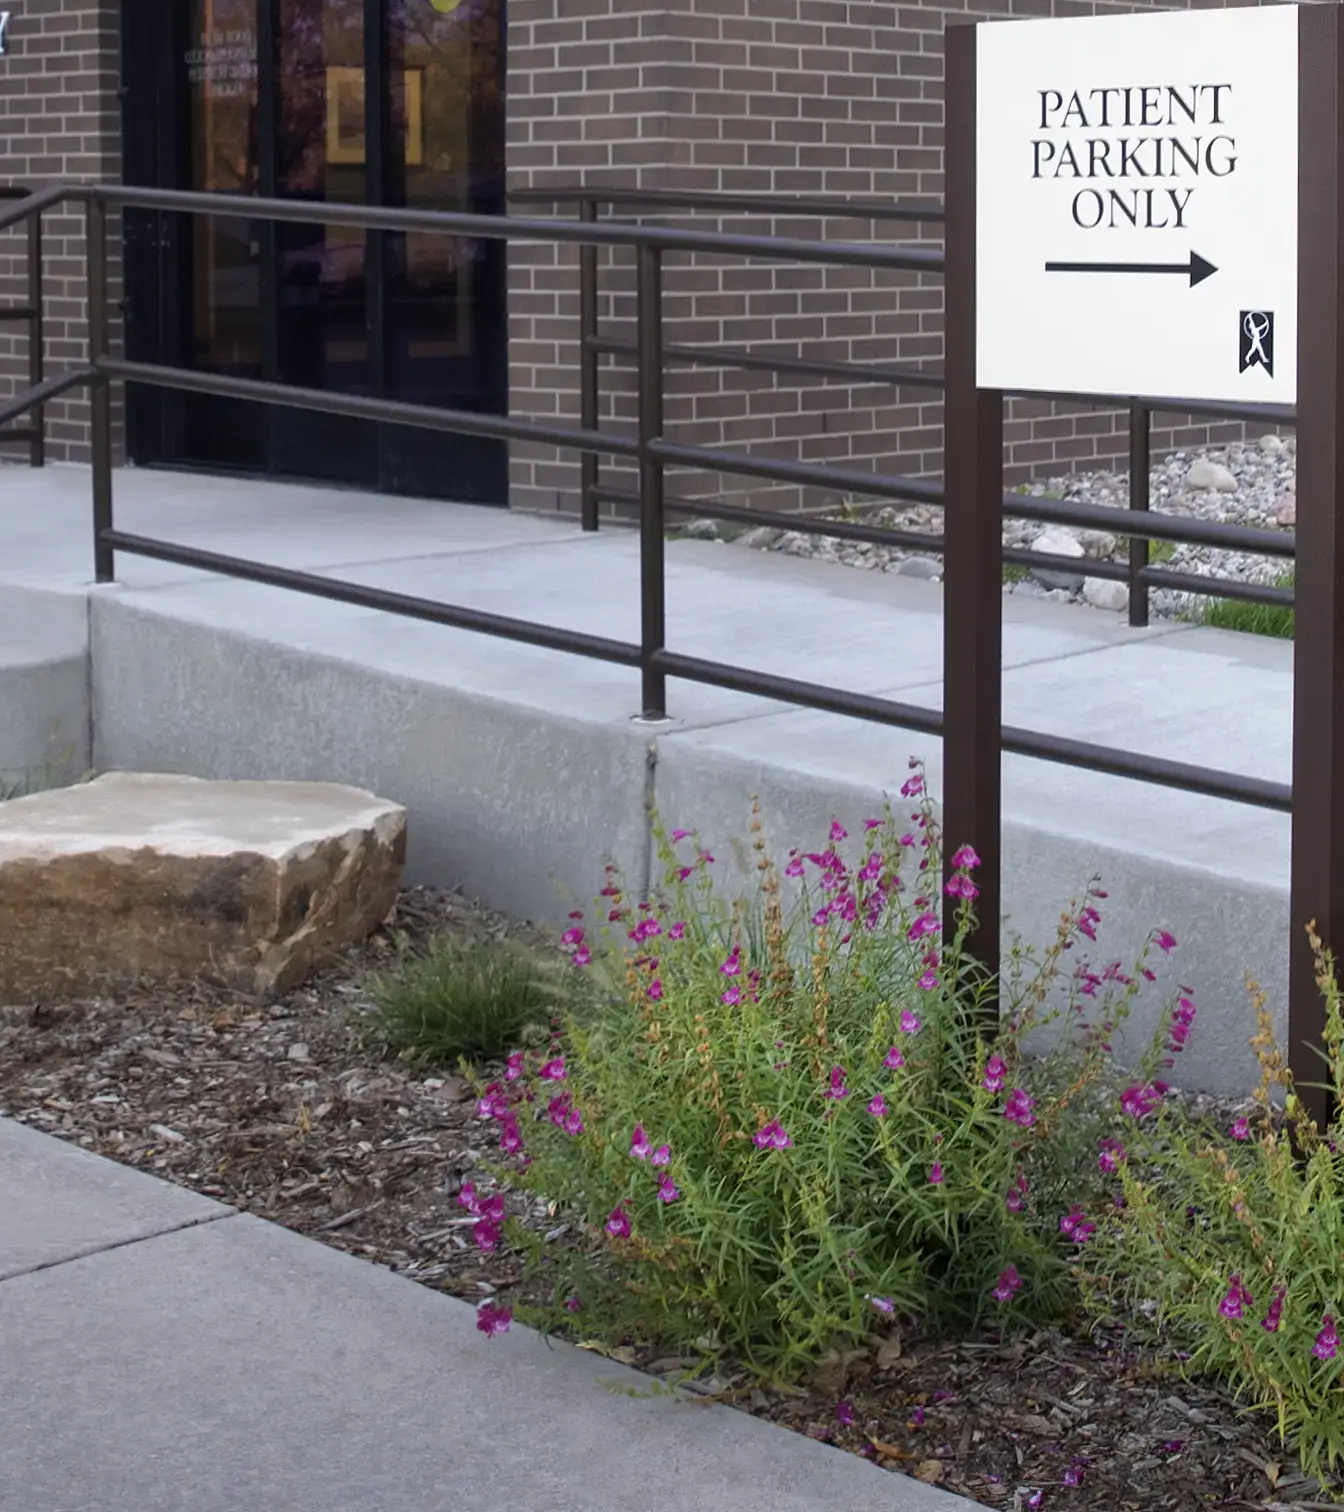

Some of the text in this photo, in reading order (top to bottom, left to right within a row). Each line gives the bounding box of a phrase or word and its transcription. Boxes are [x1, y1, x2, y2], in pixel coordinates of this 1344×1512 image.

[1037, 83, 1232, 129] PATIENT
[1030, 134, 1238, 178] PARKING
[1071, 187, 1195, 229] ONLY
